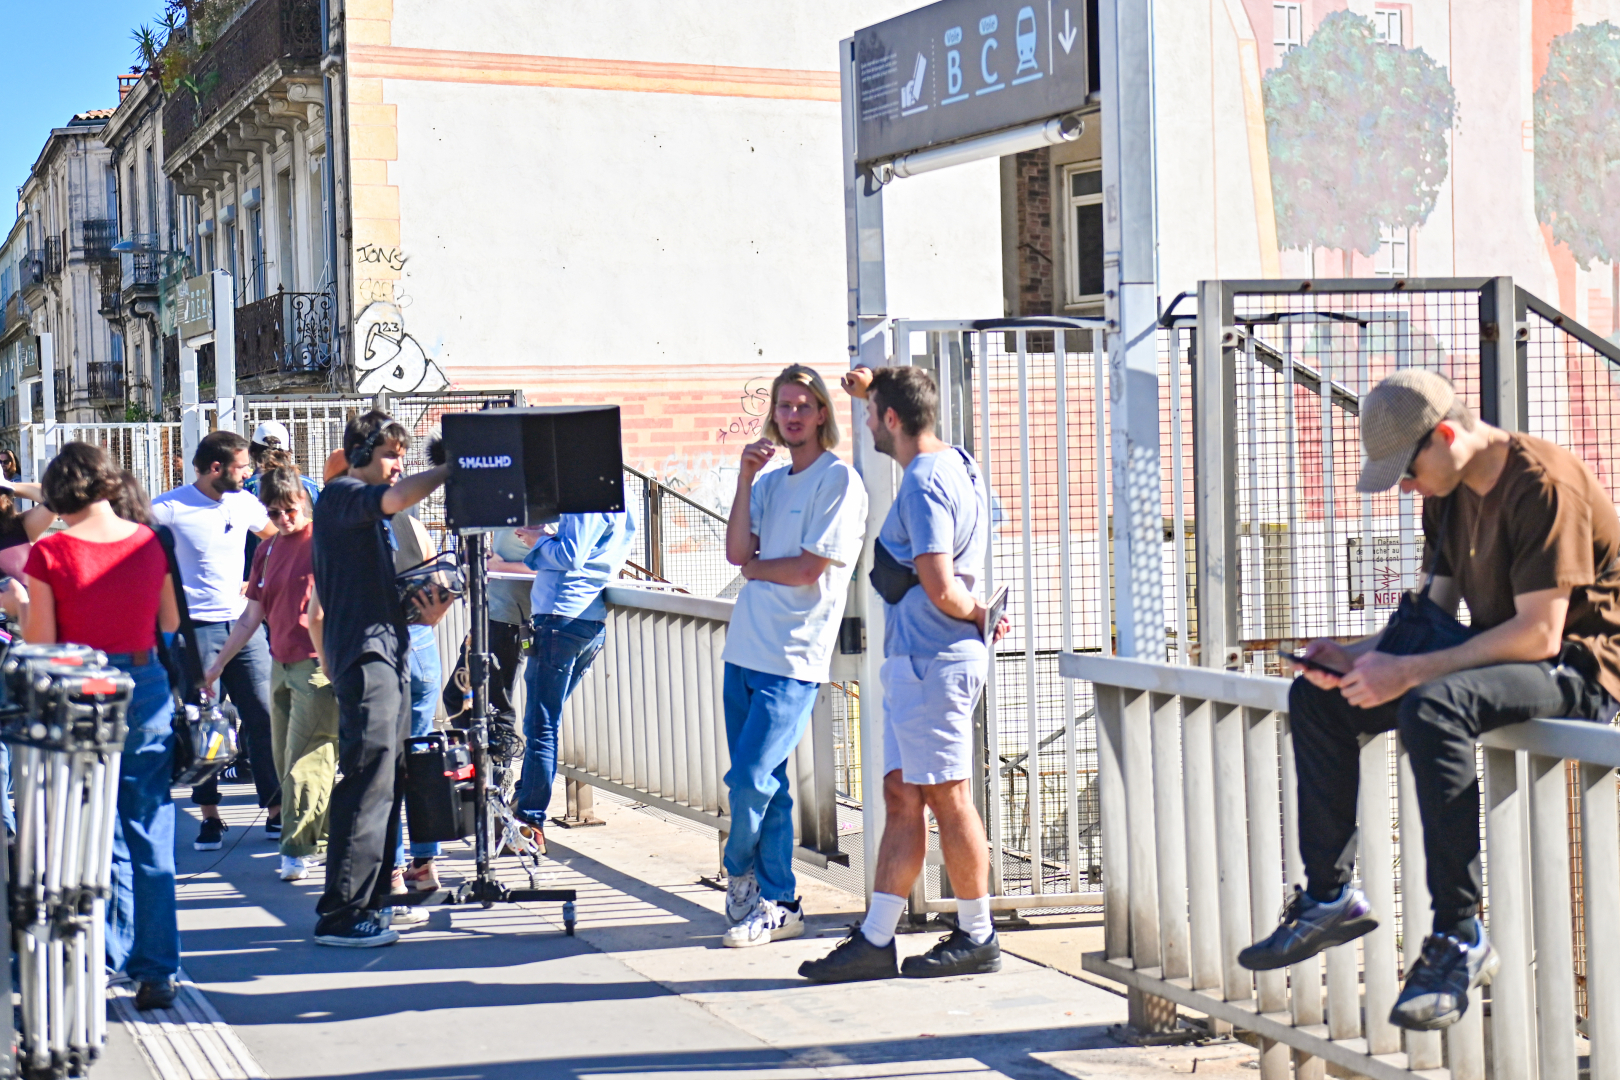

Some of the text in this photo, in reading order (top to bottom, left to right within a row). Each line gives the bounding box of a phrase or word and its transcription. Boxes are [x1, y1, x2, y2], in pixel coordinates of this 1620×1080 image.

[948, 50, 962, 94] B
[981, 37, 998, 84] C
[382, 321, 399, 333] 23
[458, 455, 512, 468] SMALLHD
